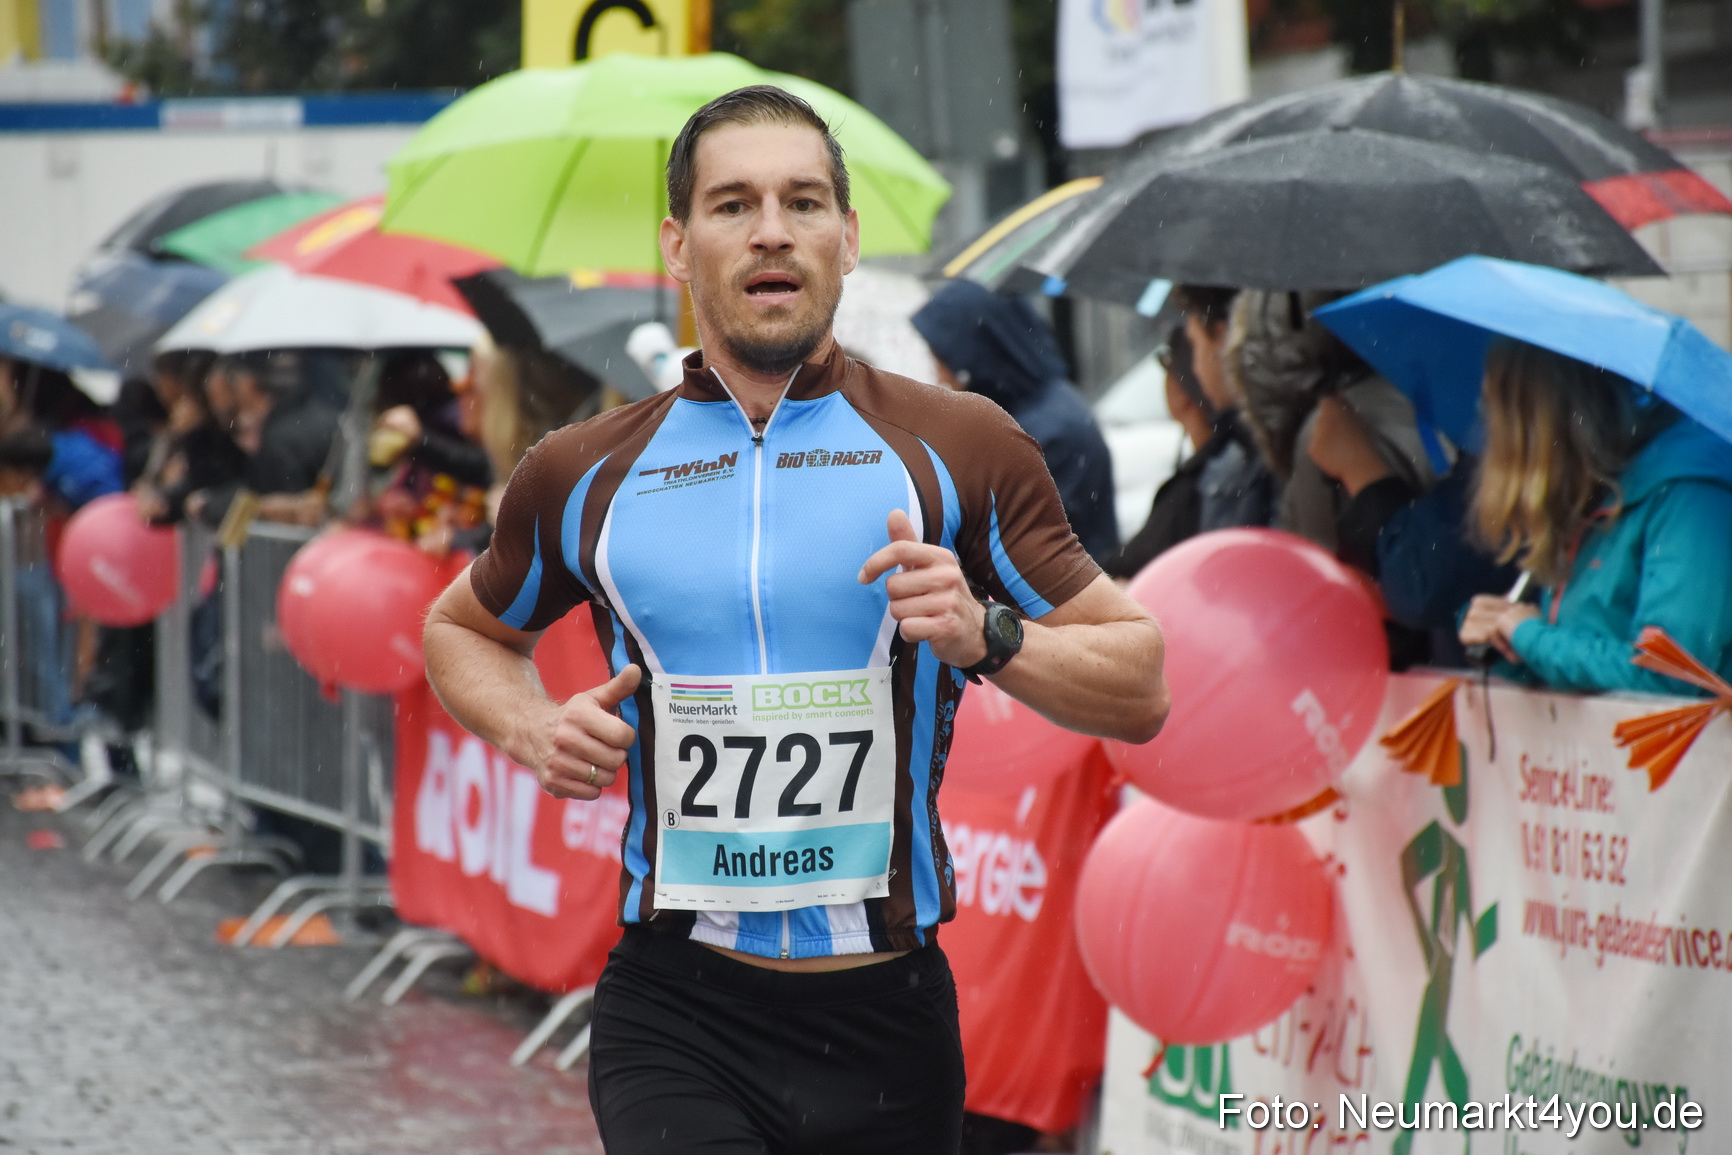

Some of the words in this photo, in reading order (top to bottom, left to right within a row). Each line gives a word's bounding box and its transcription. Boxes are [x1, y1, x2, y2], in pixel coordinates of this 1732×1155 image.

[831, 450, 883, 466] RACER
[752, 679, 872, 711] BOCK
[669, 702, 738, 716] NeuerMarkt
[752, 712, 789, 722] inspired
[791, 711, 803, 720] by
[805, 709, 832, 719] smart
[834, 707, 874, 717] concepts
[678, 729, 874, 819] 2727
[667, 812, 676, 827] B
[713, 844, 834, 878] Andreas
